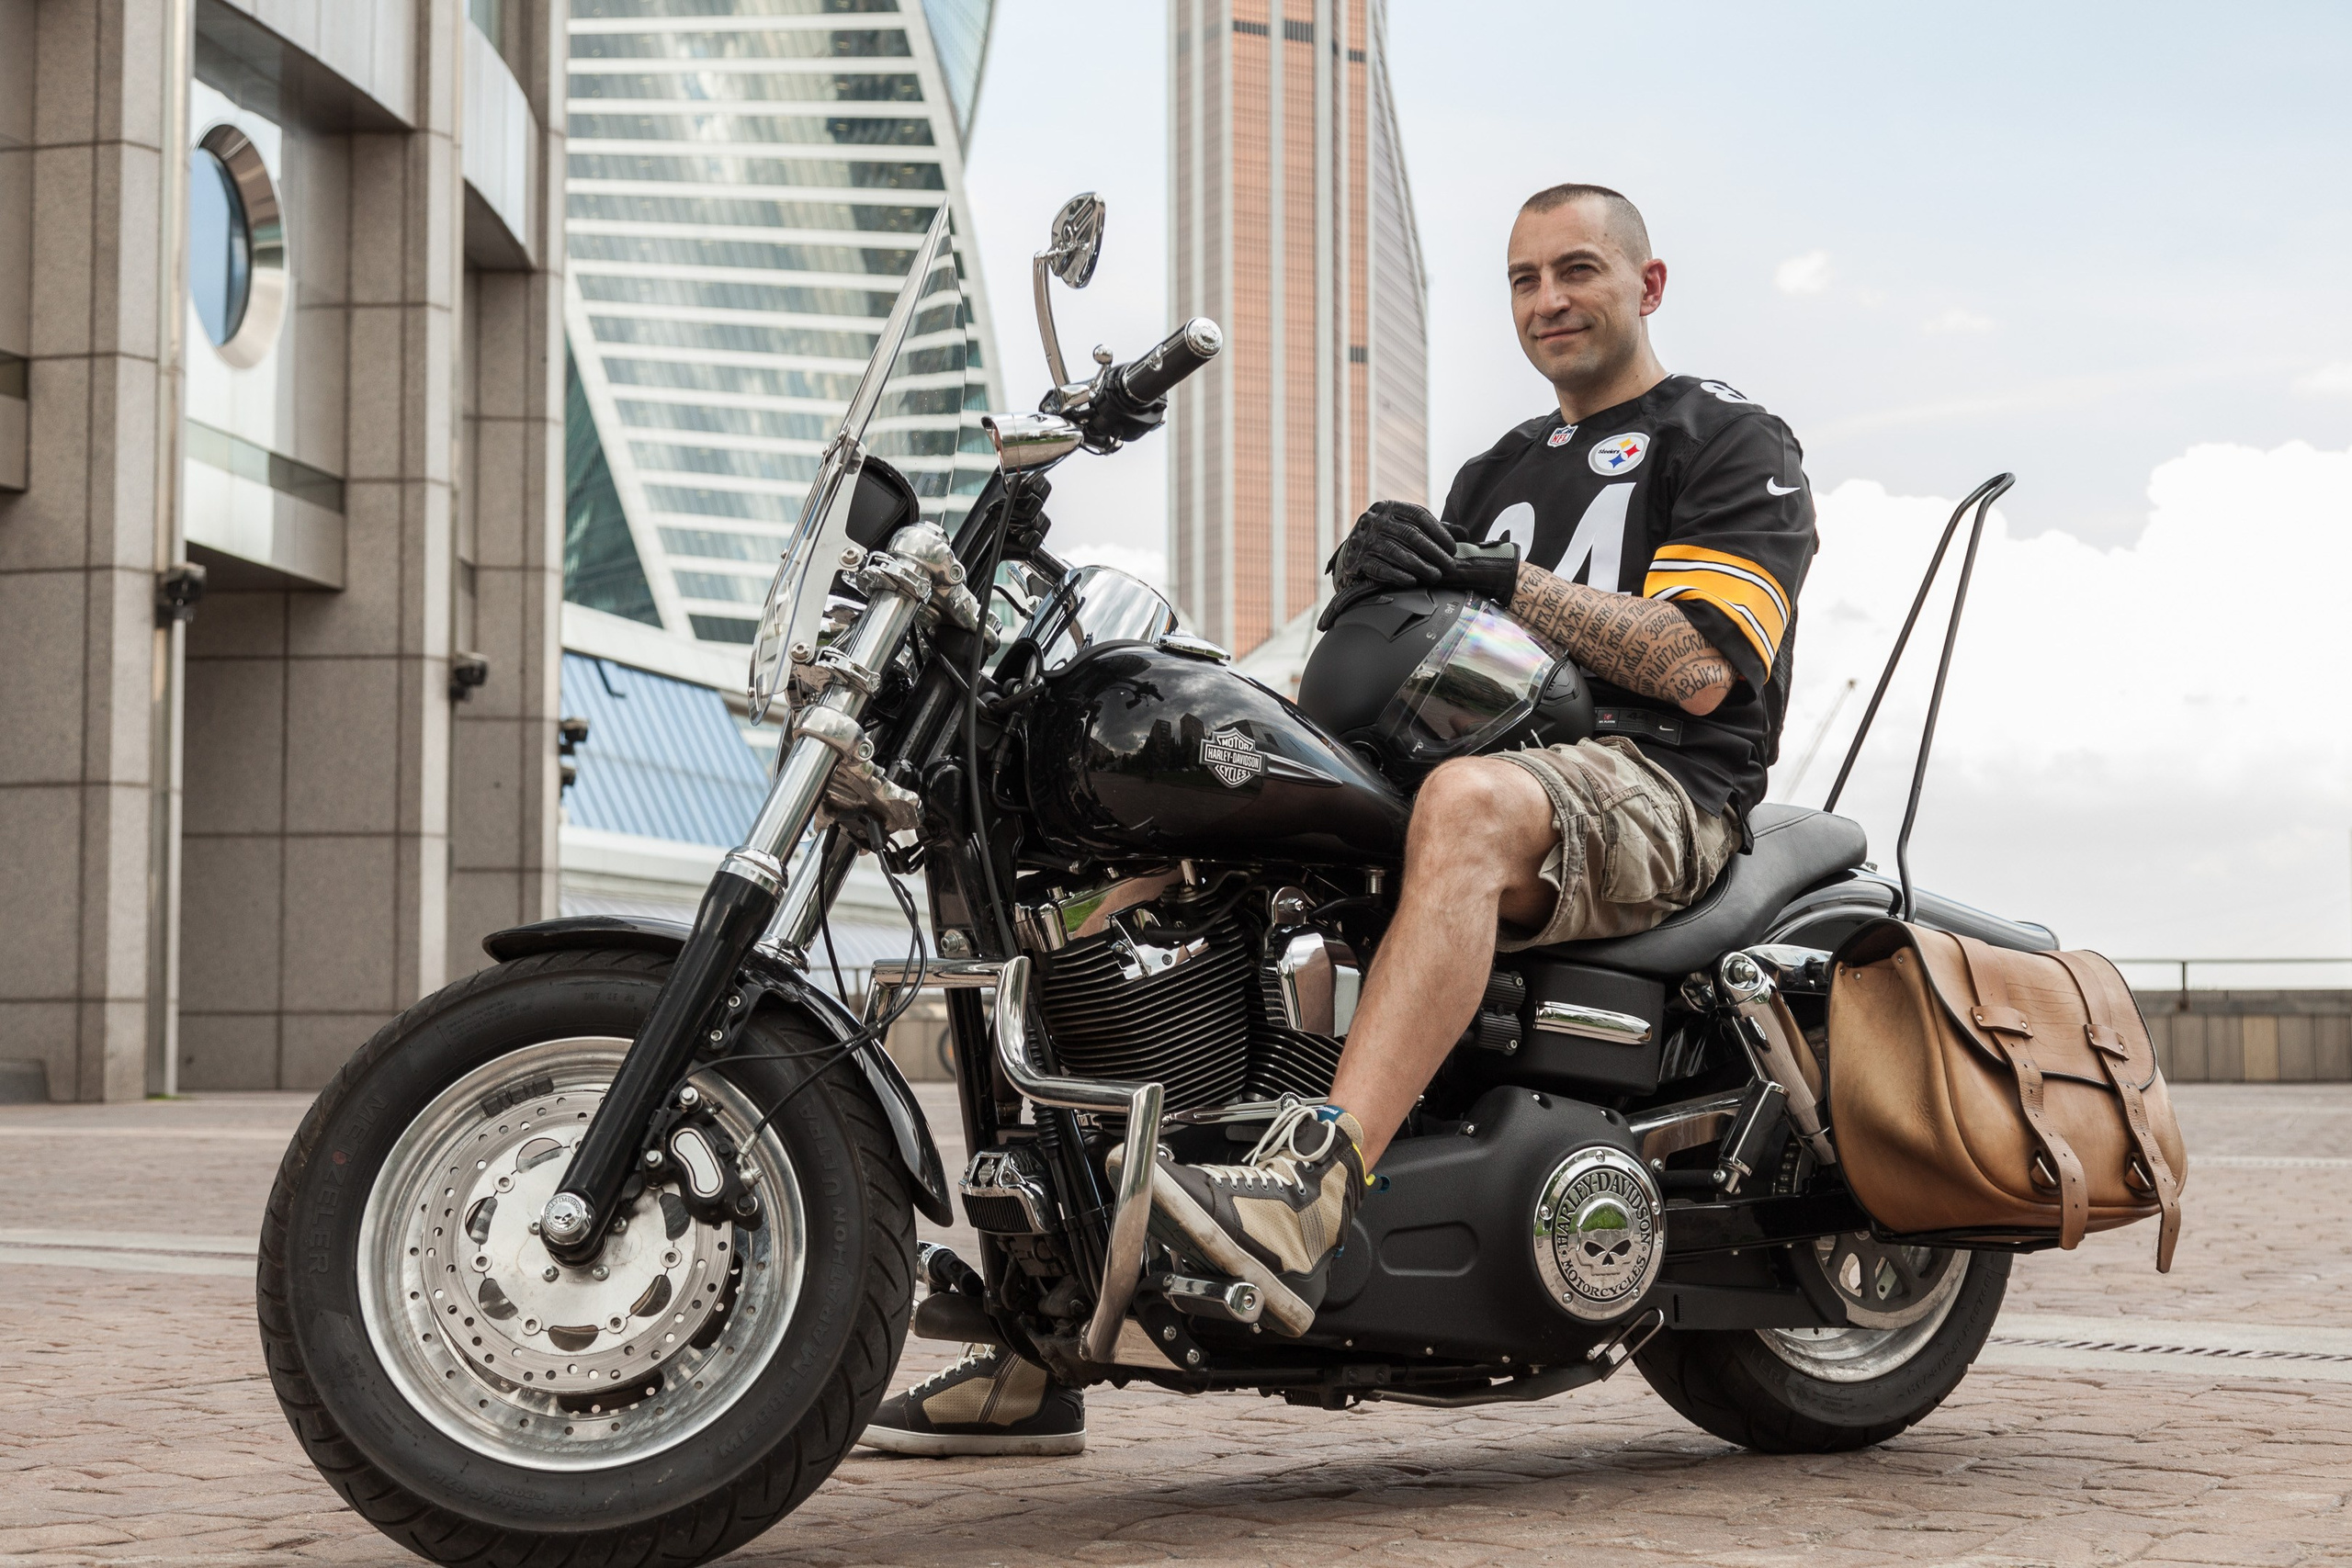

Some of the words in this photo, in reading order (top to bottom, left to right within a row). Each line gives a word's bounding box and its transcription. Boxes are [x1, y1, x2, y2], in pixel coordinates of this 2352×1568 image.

[1552, 434, 1567, 443] NFL
[1426, 601, 1460, 640] Serth
[1222, 736, 1249, 751] MOTOR
[1207, 747, 1260, 769] HARLEY-DAVIDSON
[1219, 765, 1248, 782] CYCLES
[1556, 1171, 1650, 1248] HARLEY-DAVIDSON
[1561, 1255, 1646, 1297] MOTORCYCLES
